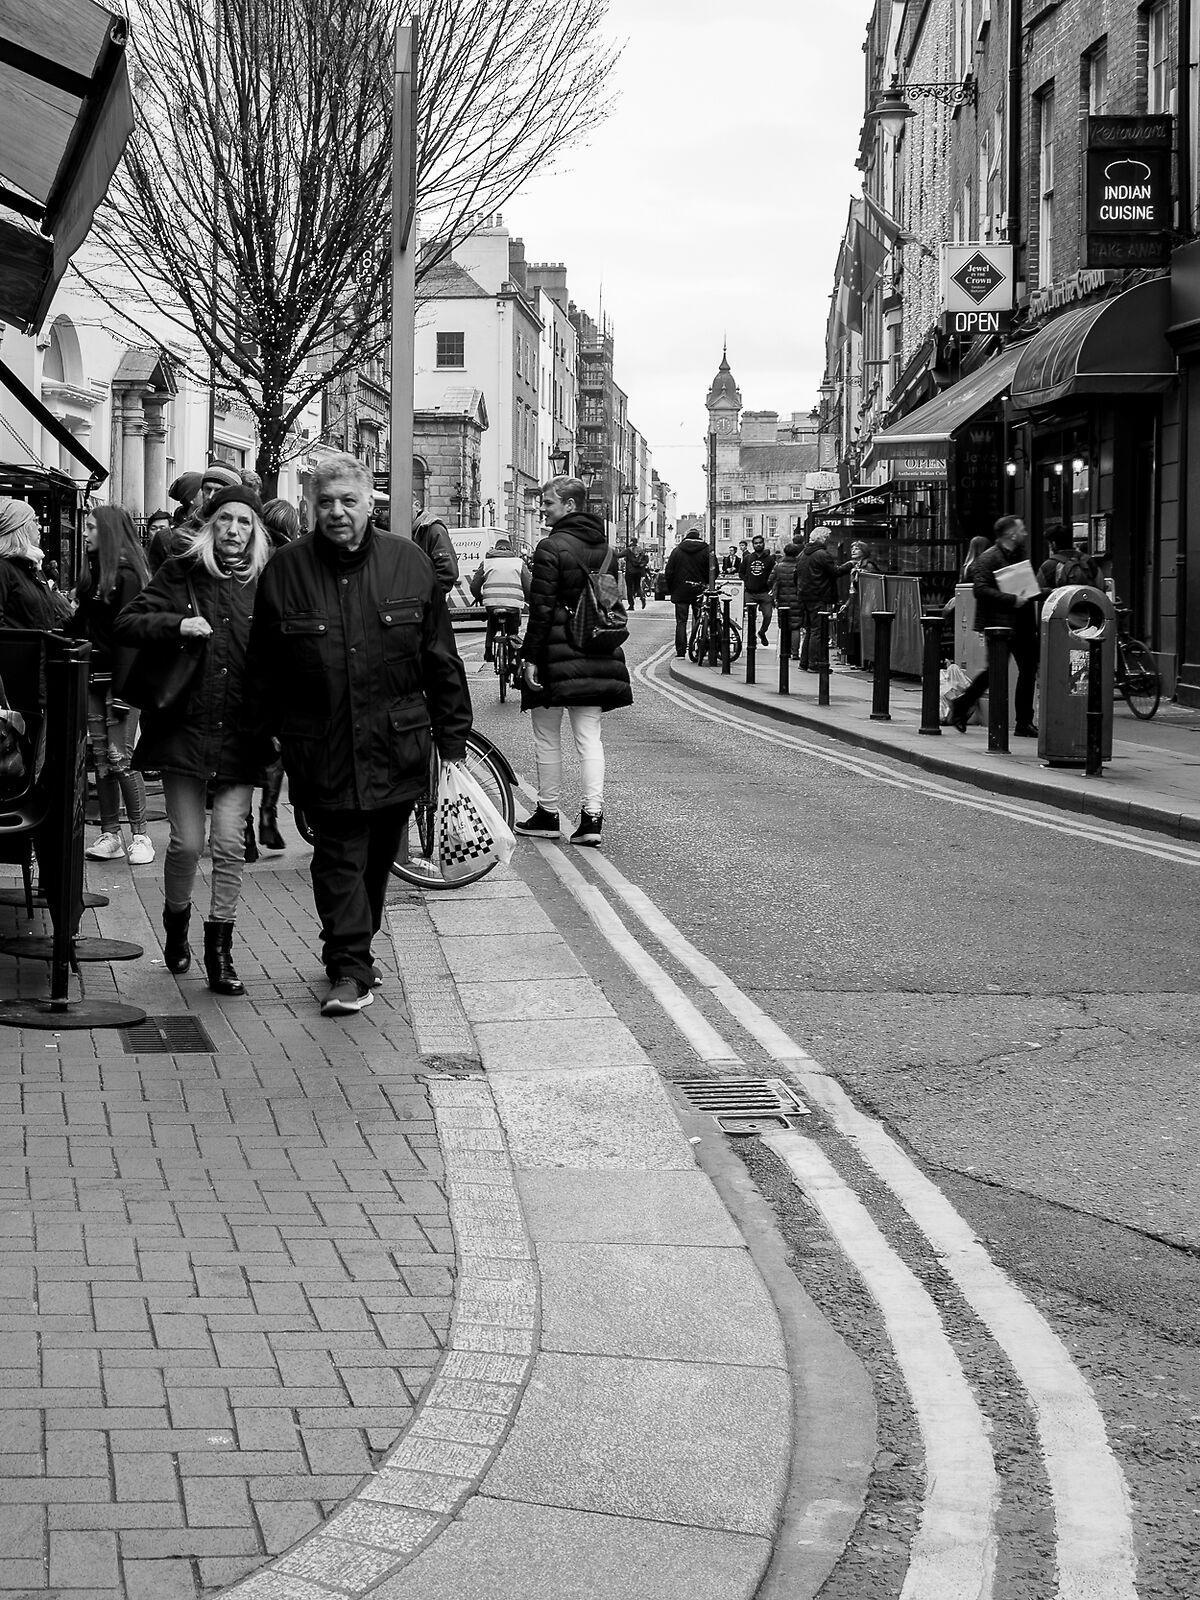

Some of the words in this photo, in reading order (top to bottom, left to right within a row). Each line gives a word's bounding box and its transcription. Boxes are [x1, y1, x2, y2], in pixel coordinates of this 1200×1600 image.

[1104, 184, 1152, 200] INDIAN
[1099, 205, 1155, 221] CUISINE
[967, 264, 990, 273] Jewel
[965, 276, 992, 284] Crown
[955, 312, 1000, 332] OPEN
[904, 459, 947, 469] OPEN
[456, 552, 480, 561] 7344
